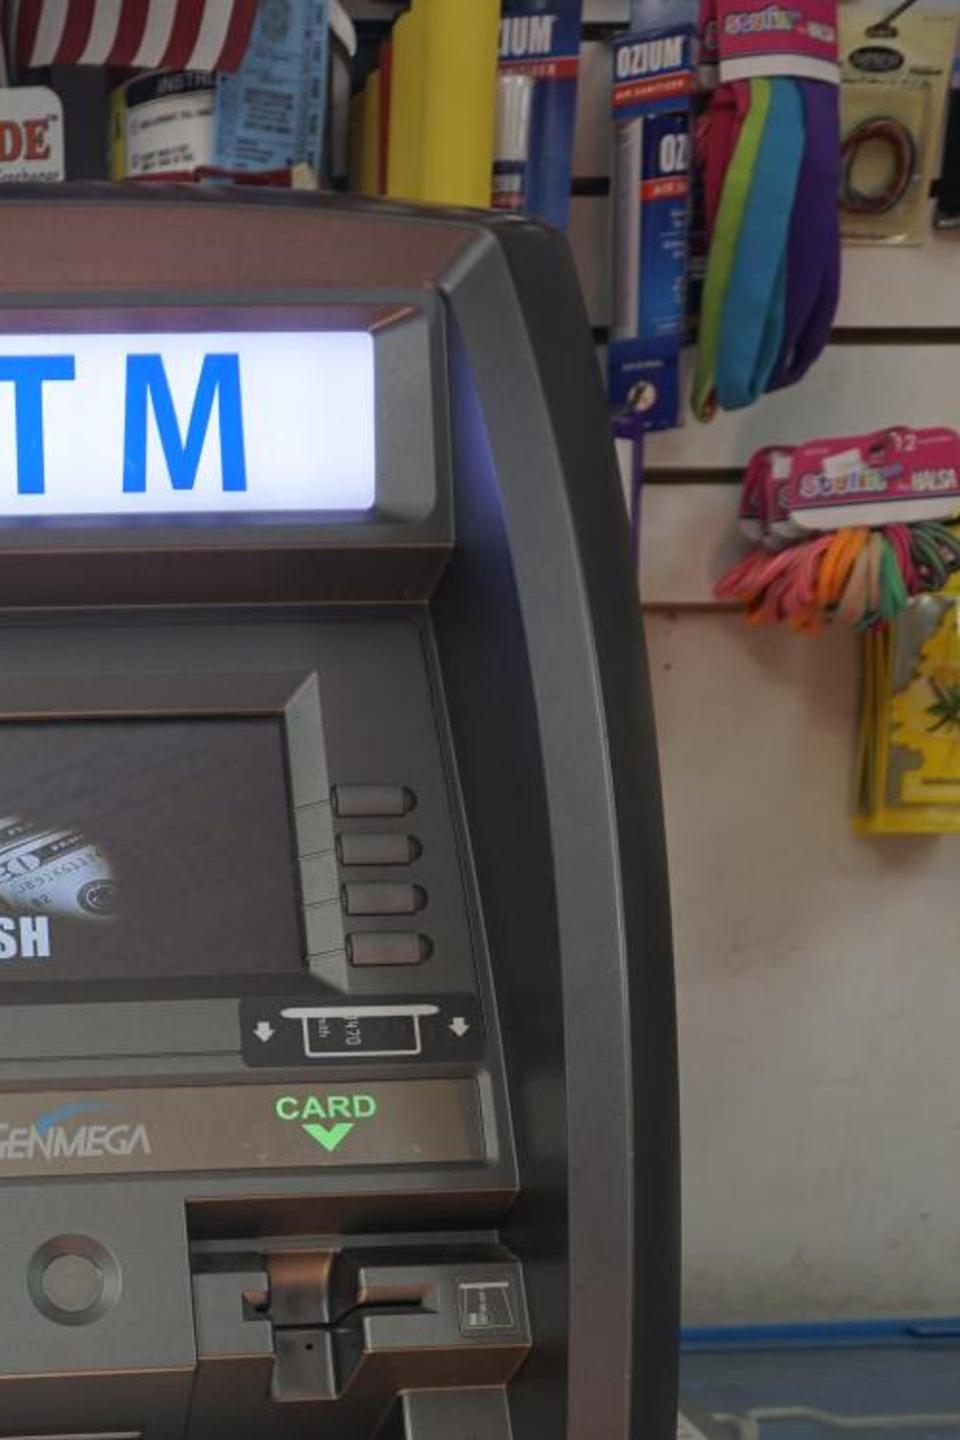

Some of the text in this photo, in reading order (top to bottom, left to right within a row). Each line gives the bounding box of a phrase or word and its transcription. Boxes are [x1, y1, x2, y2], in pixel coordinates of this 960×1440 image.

[502, 15, 557, 56] IUM
[617, 36, 686, 78] OZIUM
[275, 1095, 378, 1120] CARD
